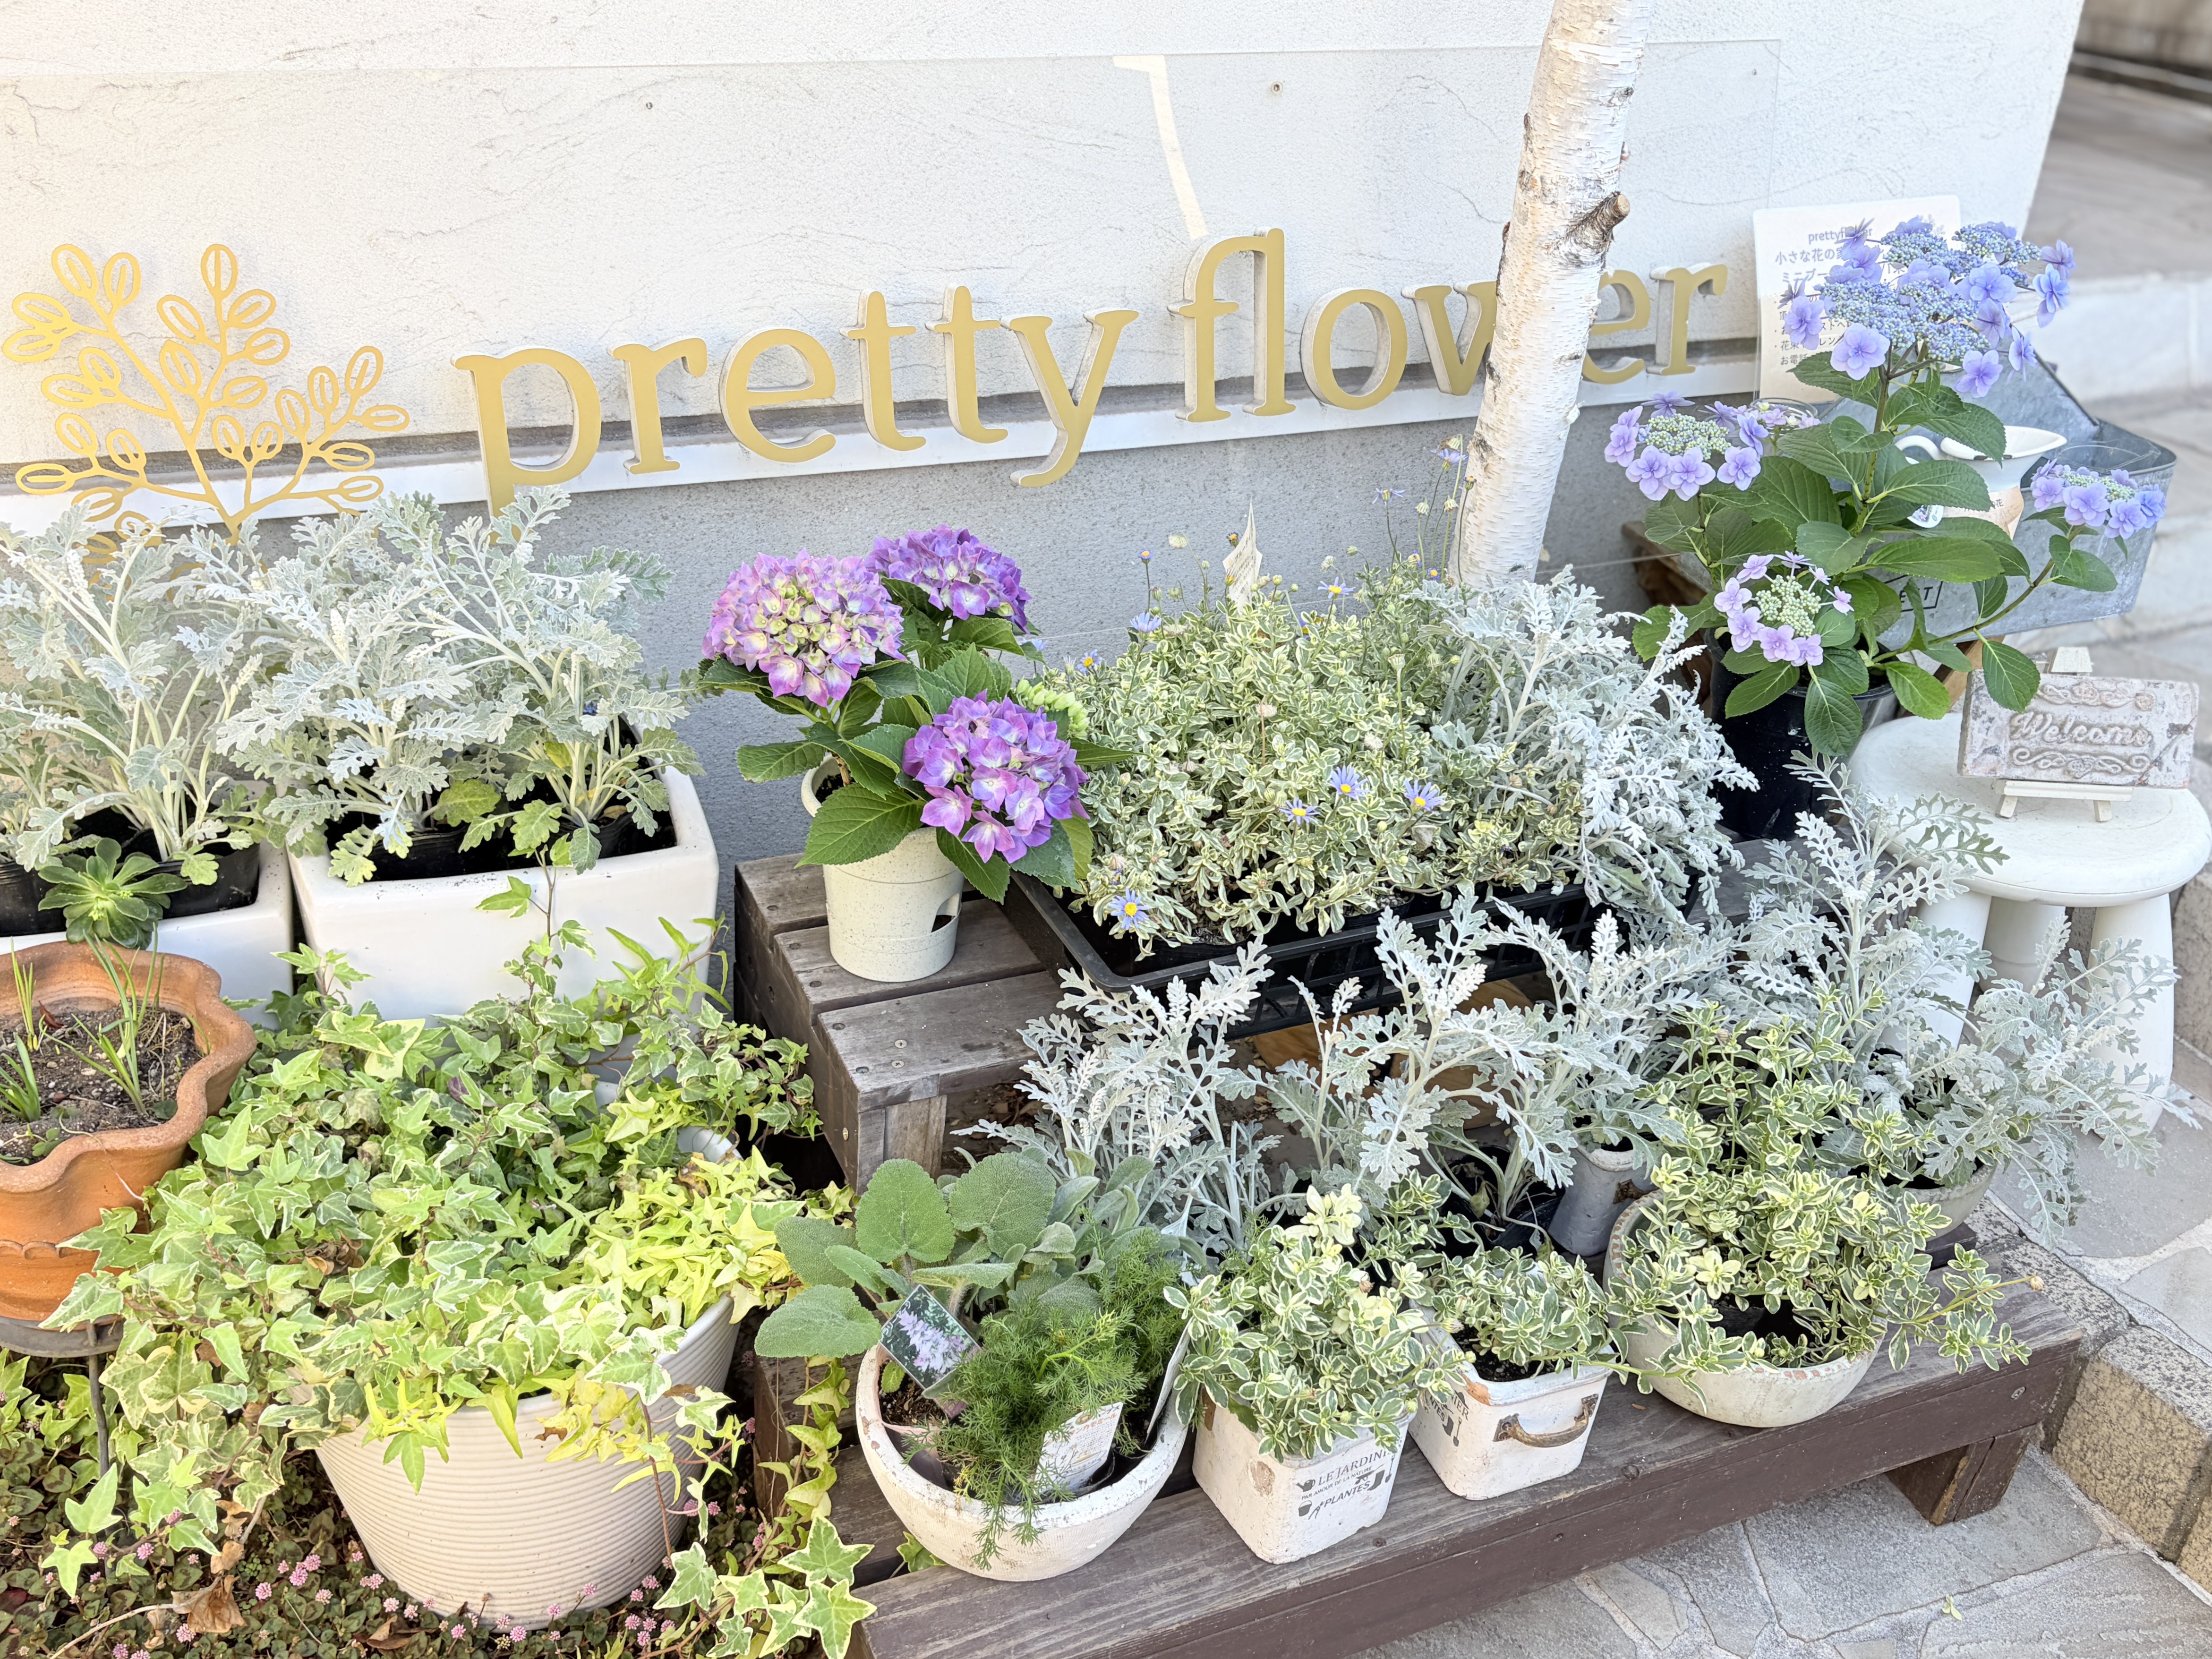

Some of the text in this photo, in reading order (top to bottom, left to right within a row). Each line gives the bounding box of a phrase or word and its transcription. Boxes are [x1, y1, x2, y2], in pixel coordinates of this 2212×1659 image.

[451, 285, 1139, 543] pretty
[2010, 711, 2152, 747] Welcome
[1314, 1483, 1333, 1496] AMOUR
[1351, 1466, 1373, 1478] NATURE
[1318, 1449, 1391, 1486] LE JARDINI
[1324, 1481, 1370, 1508] PLANTES
